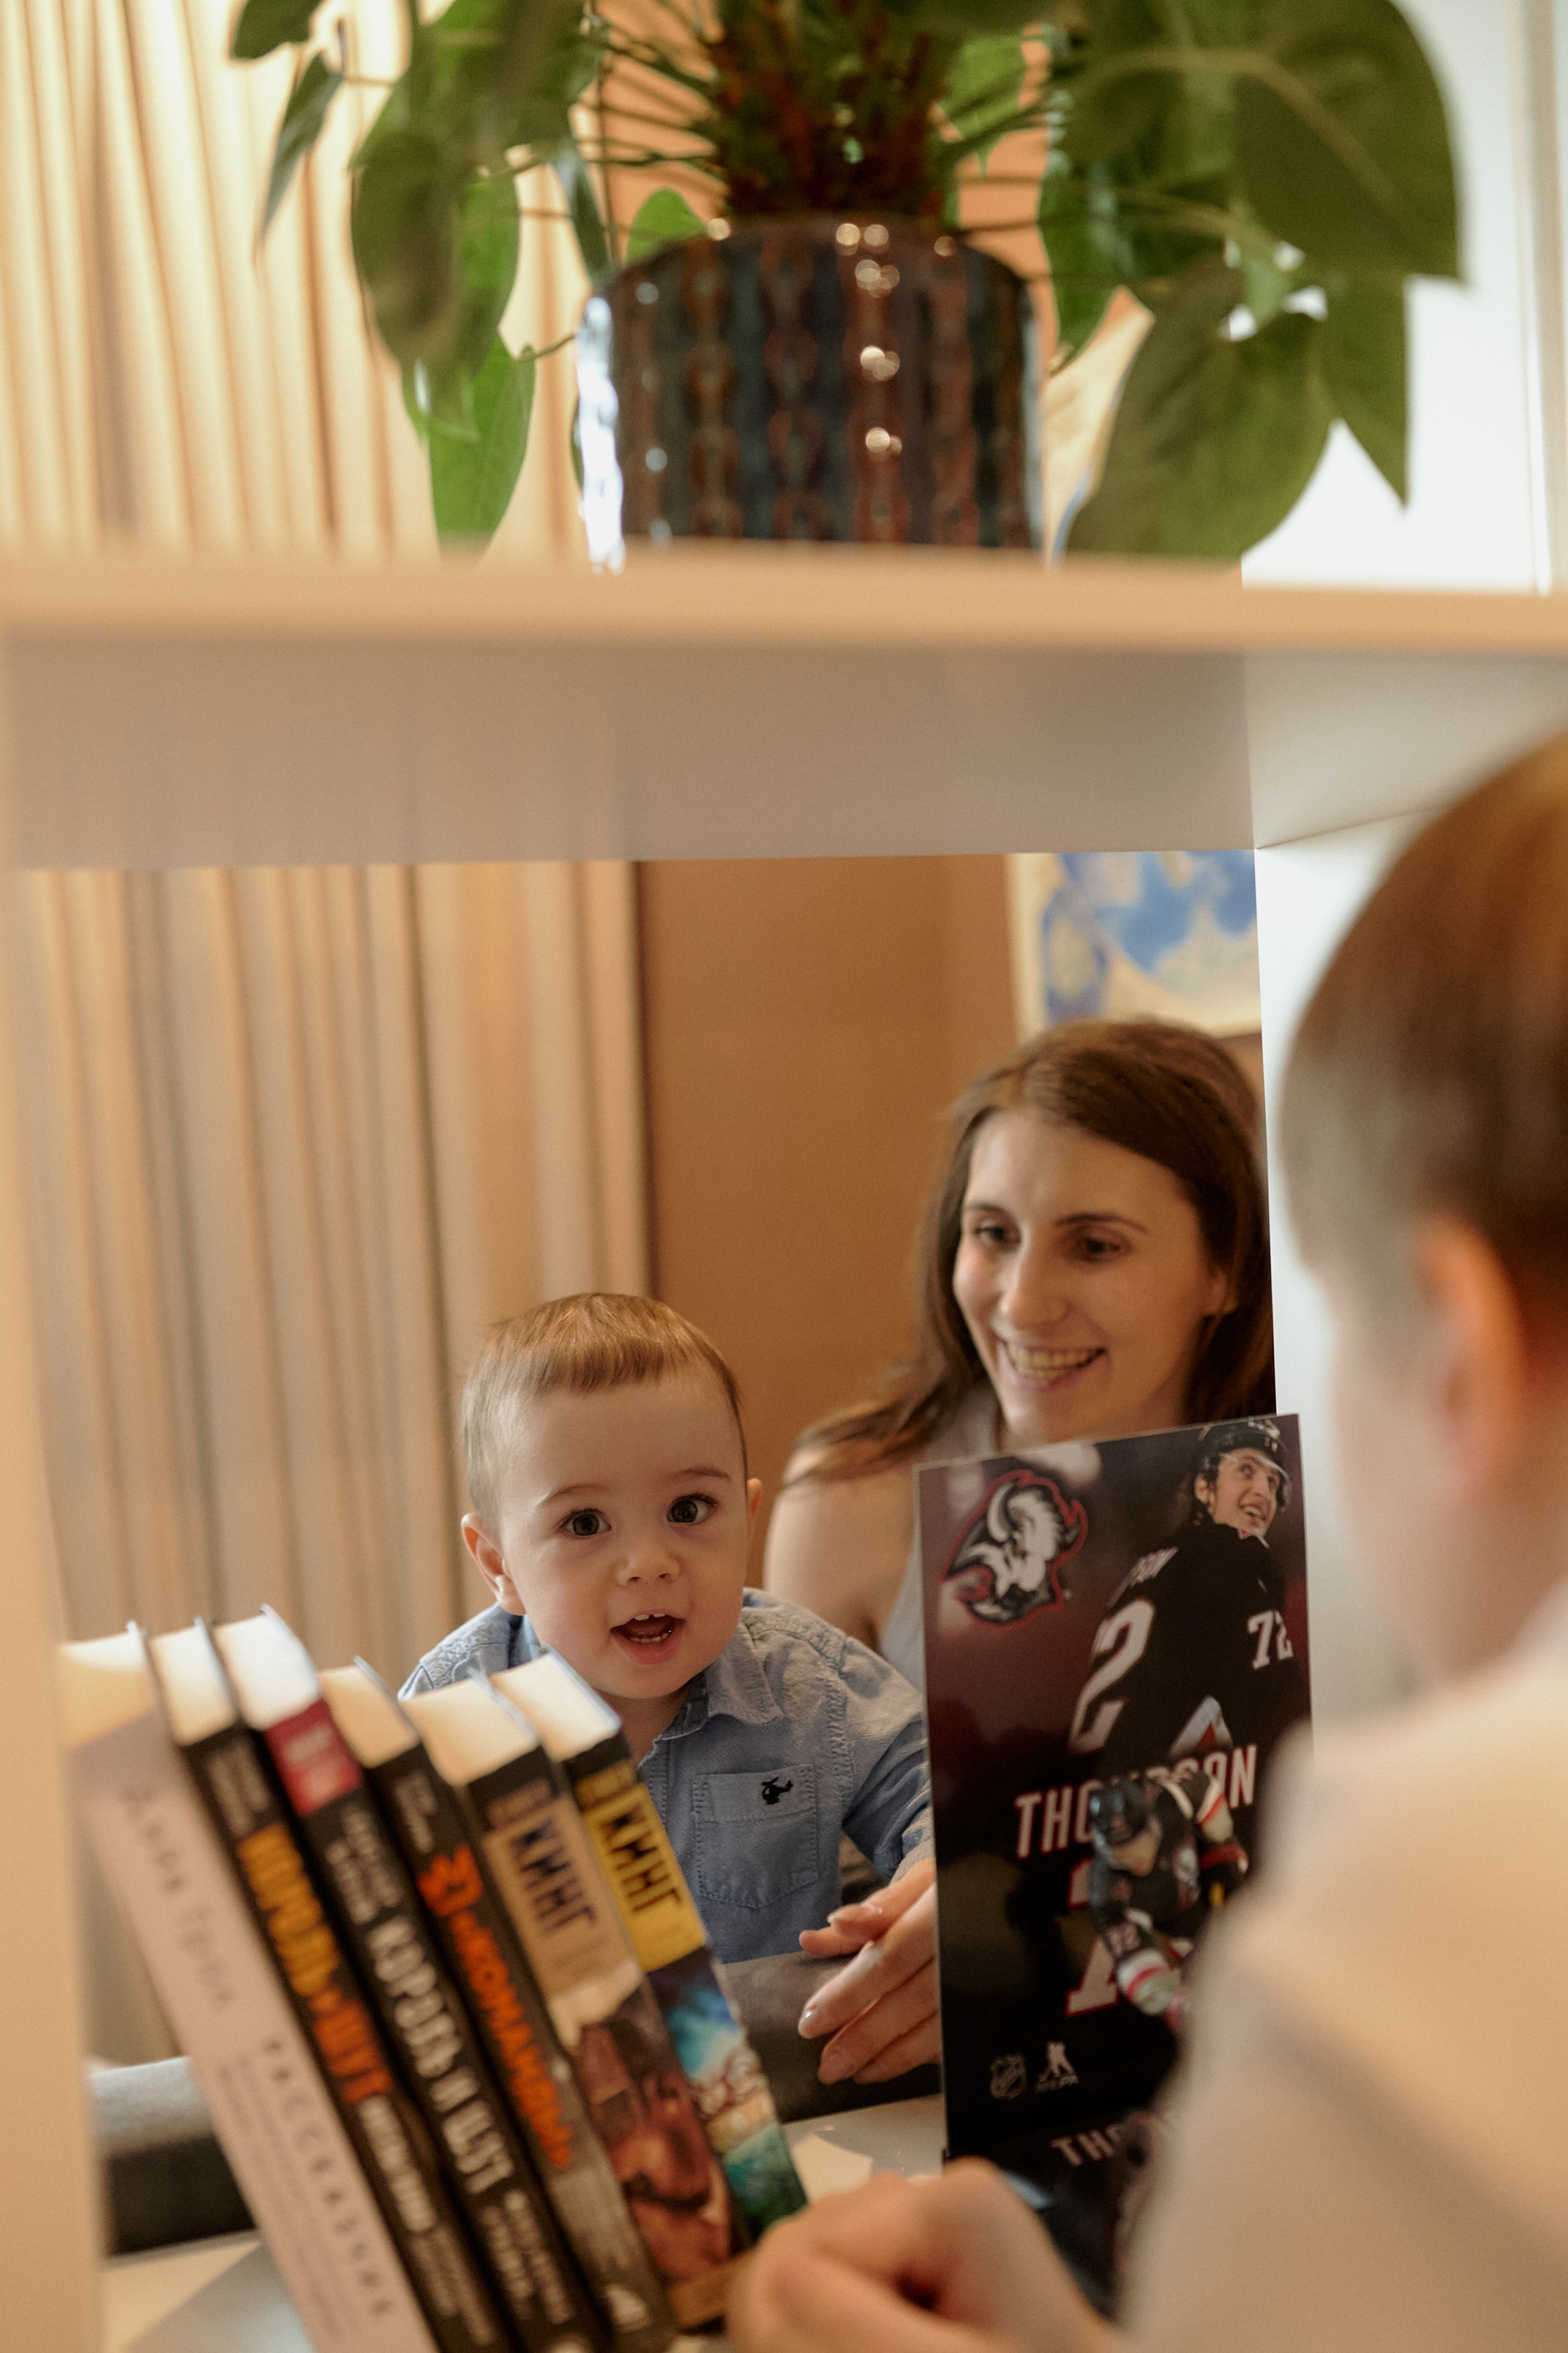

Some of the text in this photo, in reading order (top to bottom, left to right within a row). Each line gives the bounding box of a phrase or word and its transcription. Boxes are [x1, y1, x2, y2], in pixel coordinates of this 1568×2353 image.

[1246, 1609, 1294, 1670] 72
[1014, 1744, 1257, 1858] THOON
[509, 1818, 598, 1933] КИНГ
[598, 1805, 682, 1913] КИНГ
